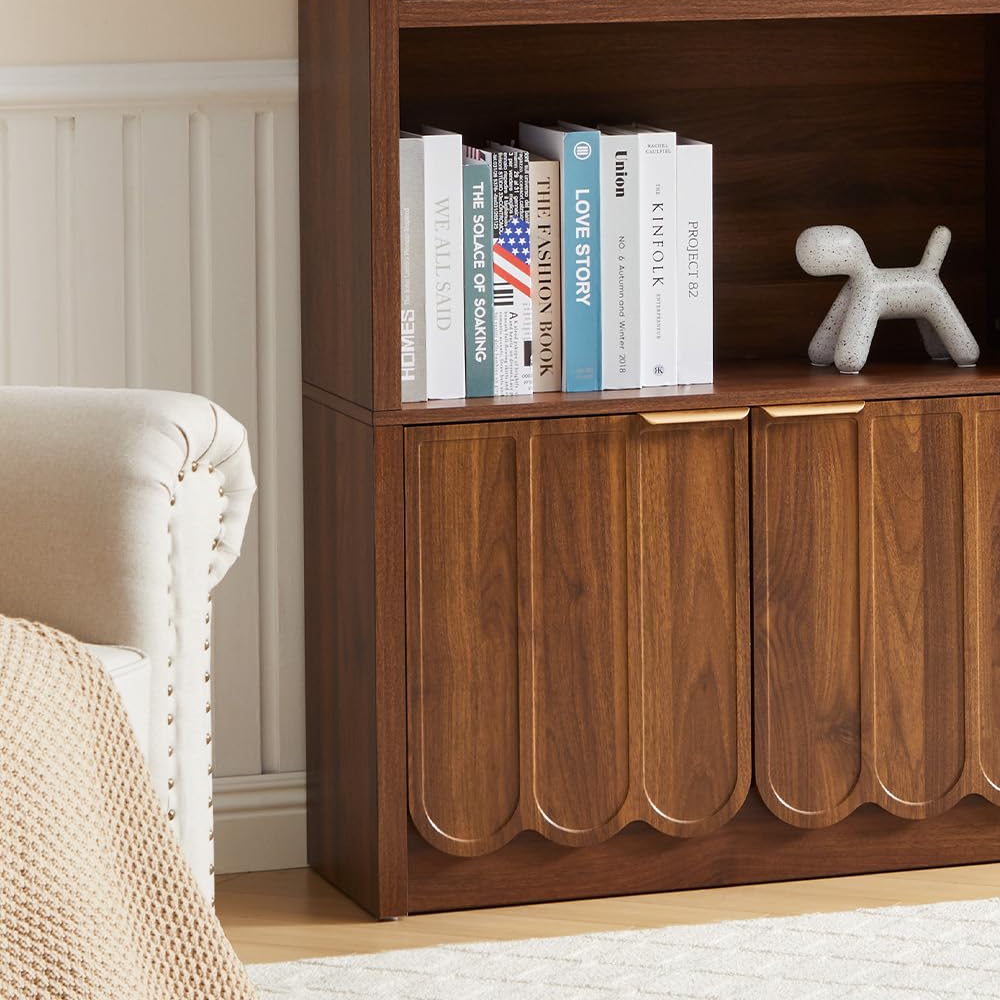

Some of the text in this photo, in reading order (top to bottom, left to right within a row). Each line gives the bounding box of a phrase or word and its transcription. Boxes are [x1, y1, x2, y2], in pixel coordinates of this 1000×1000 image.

[615, 150, 628, 198] Union
[434, 197, 452, 331] WE ALL SAID
[472, 181, 487, 363] THE SOLACE OF SOAKING
[536, 176, 553, 377] THE FASHION BOOK
[575, 188, 591, 306] LOVE STORY
[651, 202, 664, 287] KINFOLK
[686, 221, 699, 298] PROJECT 82
[618, 265, 626, 299] Autumn
[618, 299, 626, 318] and
[401, 309, 416, 381] HOMES
[618, 320, 627, 350] Winter
[618, 354, 627, 374] 2018
